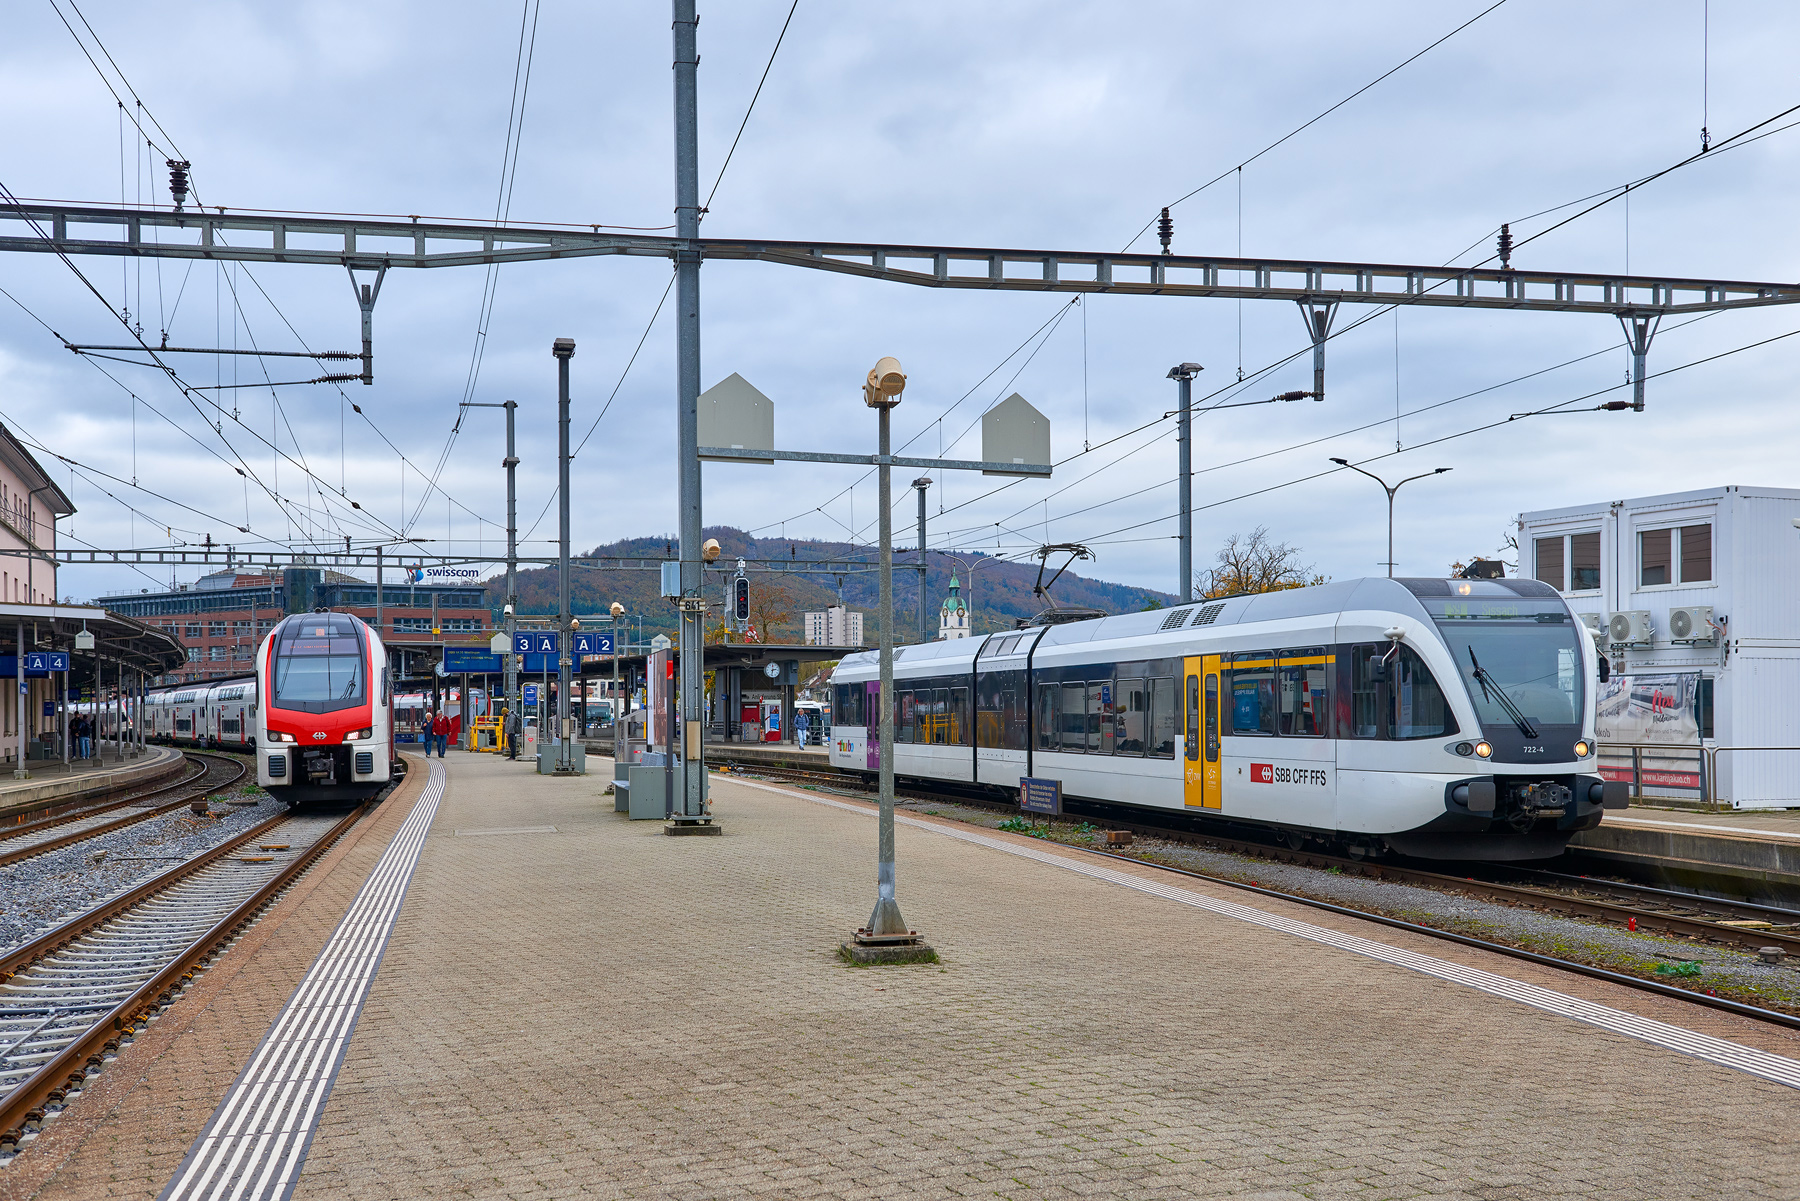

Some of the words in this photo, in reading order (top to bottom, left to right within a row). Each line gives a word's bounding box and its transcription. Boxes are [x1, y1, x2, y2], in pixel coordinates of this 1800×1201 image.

[427, 567, 479, 577] swisscom
[685, 601, 700, 610] 641
[1482, 603, 1518, 617] Sissach
[520, 639, 529, 651] 3
[541, 639, 552, 651] A
[579, 639, 589, 651] A
[601, 639, 610, 651] 2
[33, 658, 43, 668] A
[54, 658, 63, 668] 4
[1652, 690, 1677, 714] Neu
[1275, 767, 1291, 783] SBB
[1293, 768, 1308, 784] CFF
[1310, 769, 1327, 786] FFS
